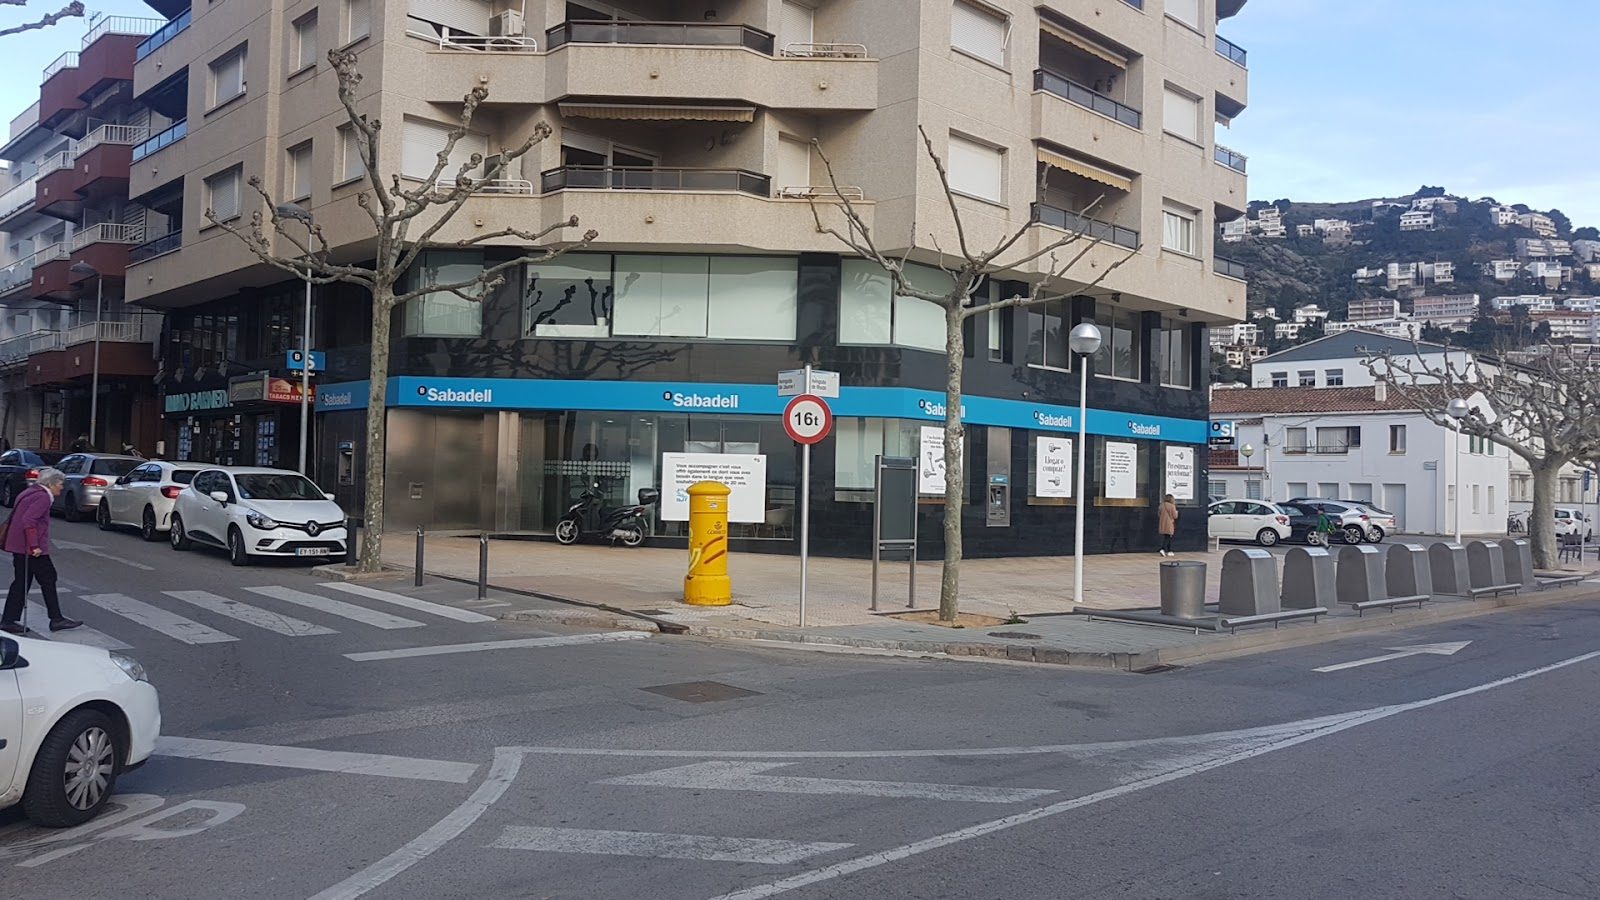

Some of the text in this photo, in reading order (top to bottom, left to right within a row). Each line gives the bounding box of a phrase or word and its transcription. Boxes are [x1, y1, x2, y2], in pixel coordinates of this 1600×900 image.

[324, 391, 352, 406] Sabadell
[428, 387, 492, 403] Sabadell
[673, 392, 739, 409] Sabadell
[925, 401, 966, 419] Sabll
[1038, 412, 1073, 428] Sabadell
[1132, 422, 1161, 436] Sabadell
